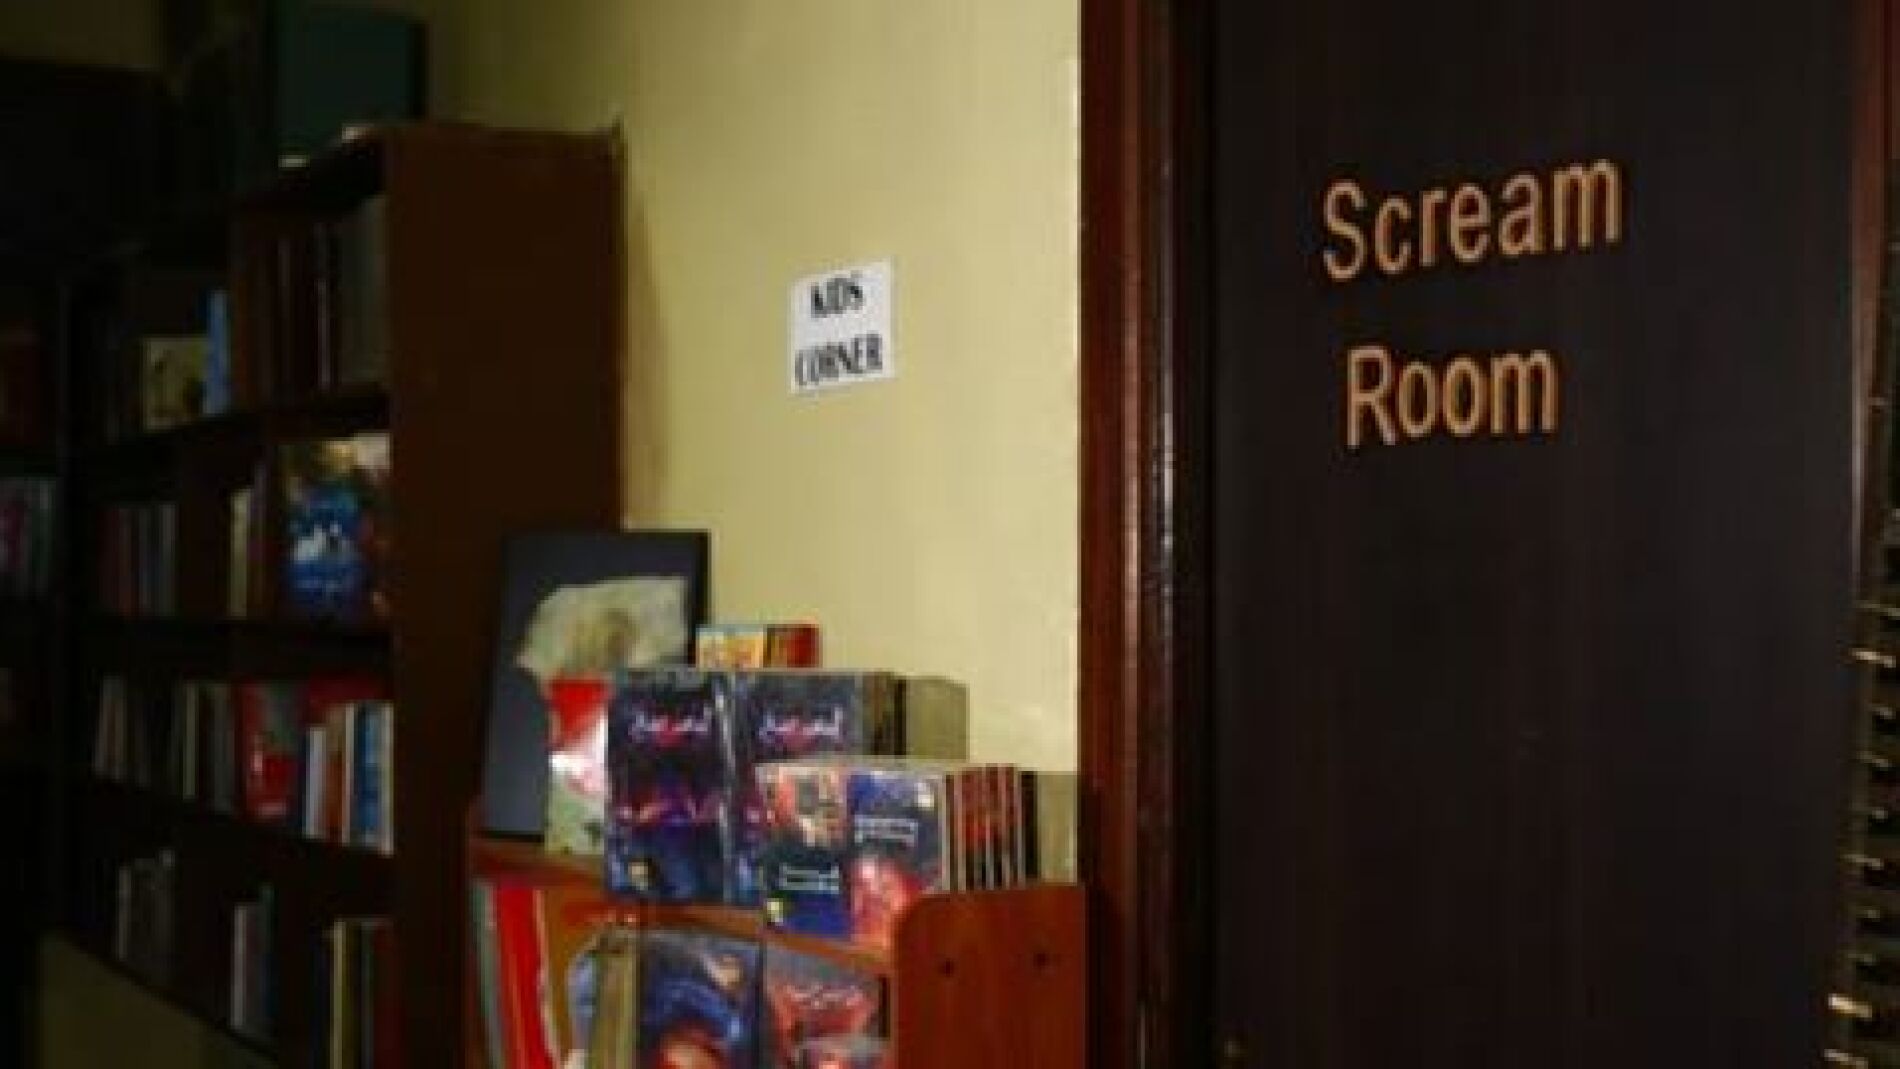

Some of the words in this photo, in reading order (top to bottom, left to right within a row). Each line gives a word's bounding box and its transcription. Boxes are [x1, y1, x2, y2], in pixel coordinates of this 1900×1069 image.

[1323, 158, 1622, 281] Scream
[810, 272, 864, 319] KIDS
[794, 333, 883, 386] CORNER
[1346, 345, 1559, 448] Room
